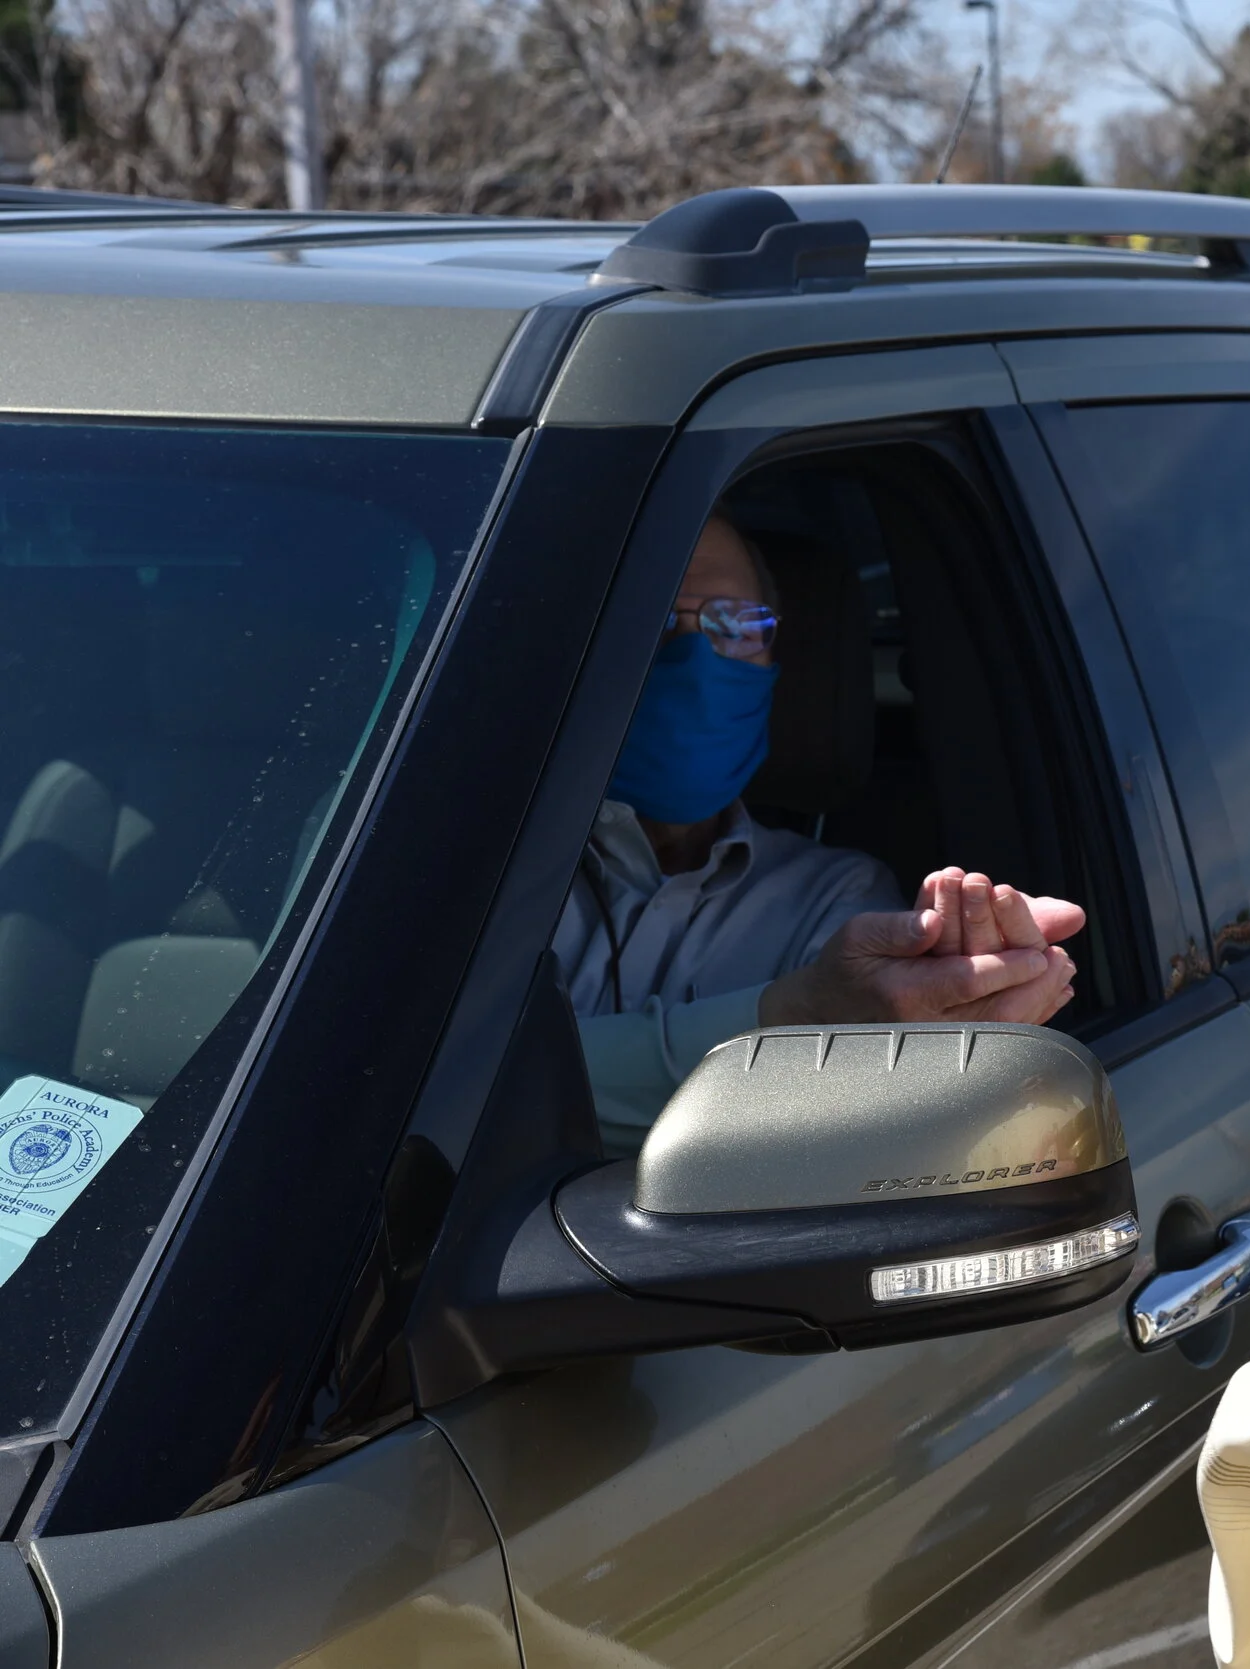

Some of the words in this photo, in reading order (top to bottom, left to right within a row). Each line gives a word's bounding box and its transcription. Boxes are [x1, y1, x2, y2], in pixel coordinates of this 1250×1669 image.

[40, 1091, 109, 1119] AURORA
[41, 1111, 82, 1129] Police
[73, 1129, 100, 1174] Academy
[4, 1178, 35, 1189] Through
[37, 1173, 74, 1188] Education
[860, 1158, 1057, 1193] EXPLORER
